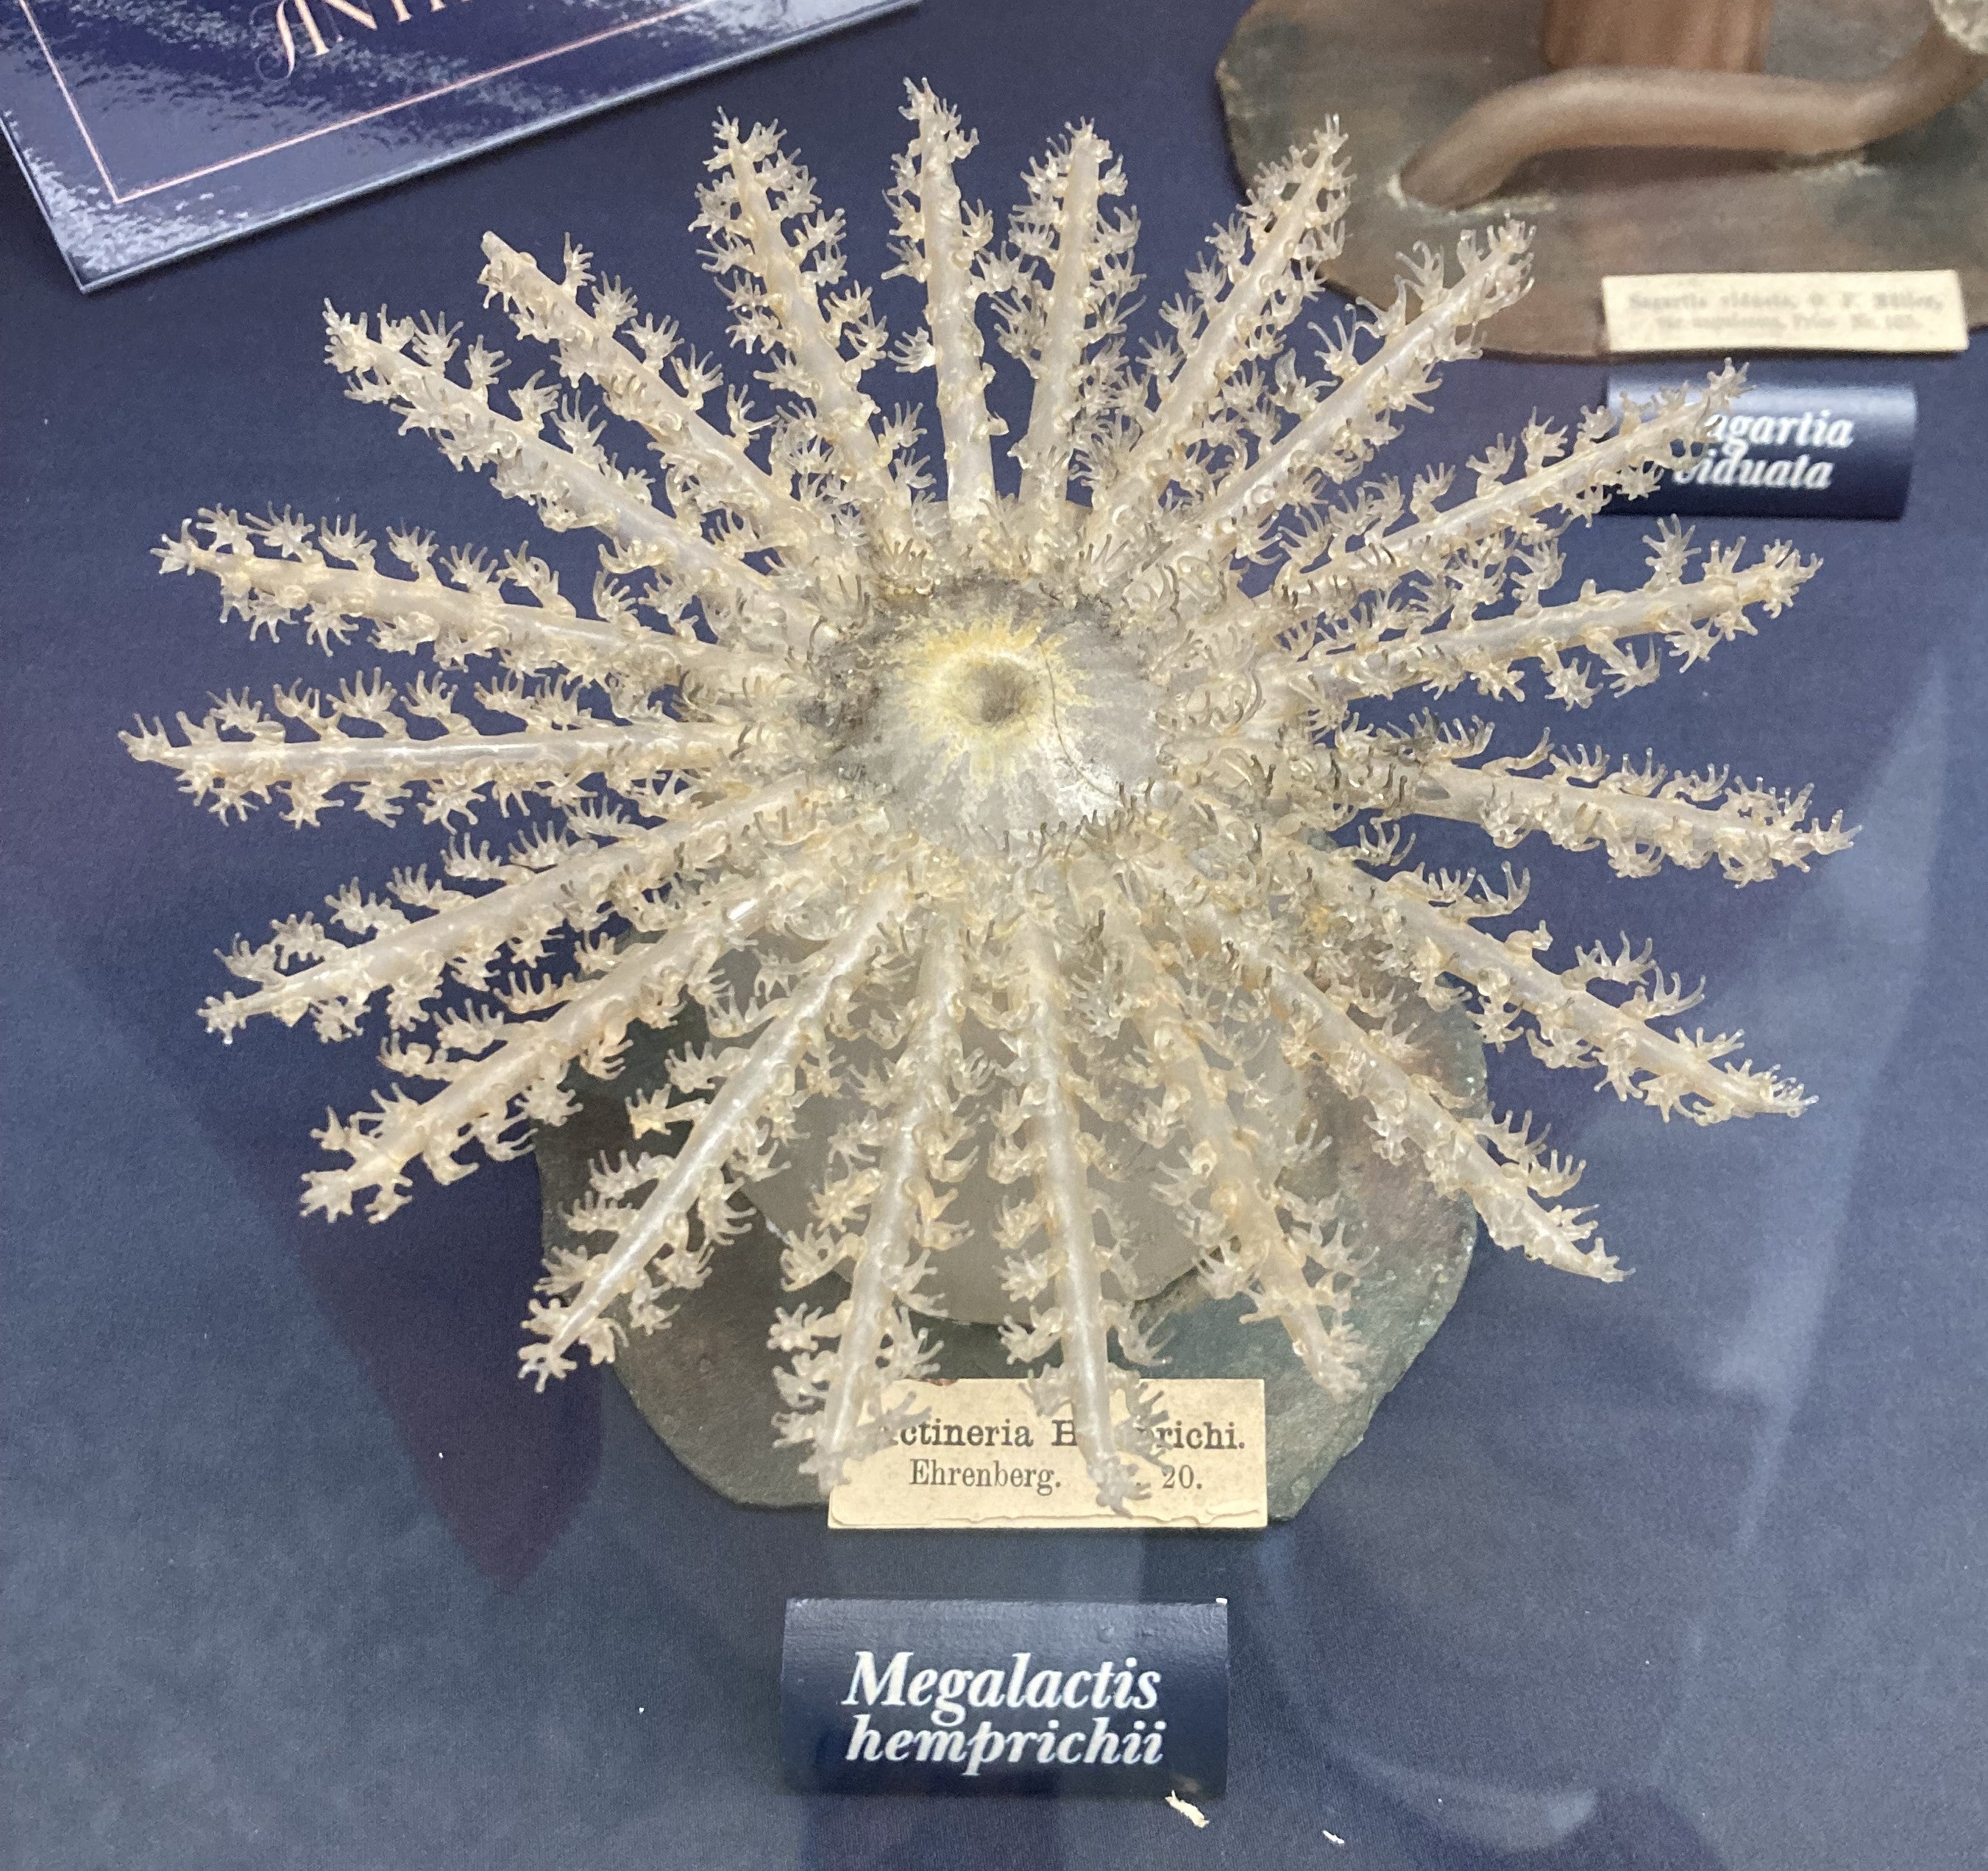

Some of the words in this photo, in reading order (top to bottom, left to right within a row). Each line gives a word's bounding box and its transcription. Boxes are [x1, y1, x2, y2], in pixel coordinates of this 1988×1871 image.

[1701, 409, 1854, 456] agartia
[892, 1418, 1034, 1447] ctineria
[1051, 1419, 1246, 1450] Hrichi.
[908, 1458, 1062, 1497] Ehrenberg.
[1161, 1464, 1203, 1489] 20.
[841, 1650, 1162, 1727] Megalactis
[845, 1714, 1168, 1776] hemprichii
